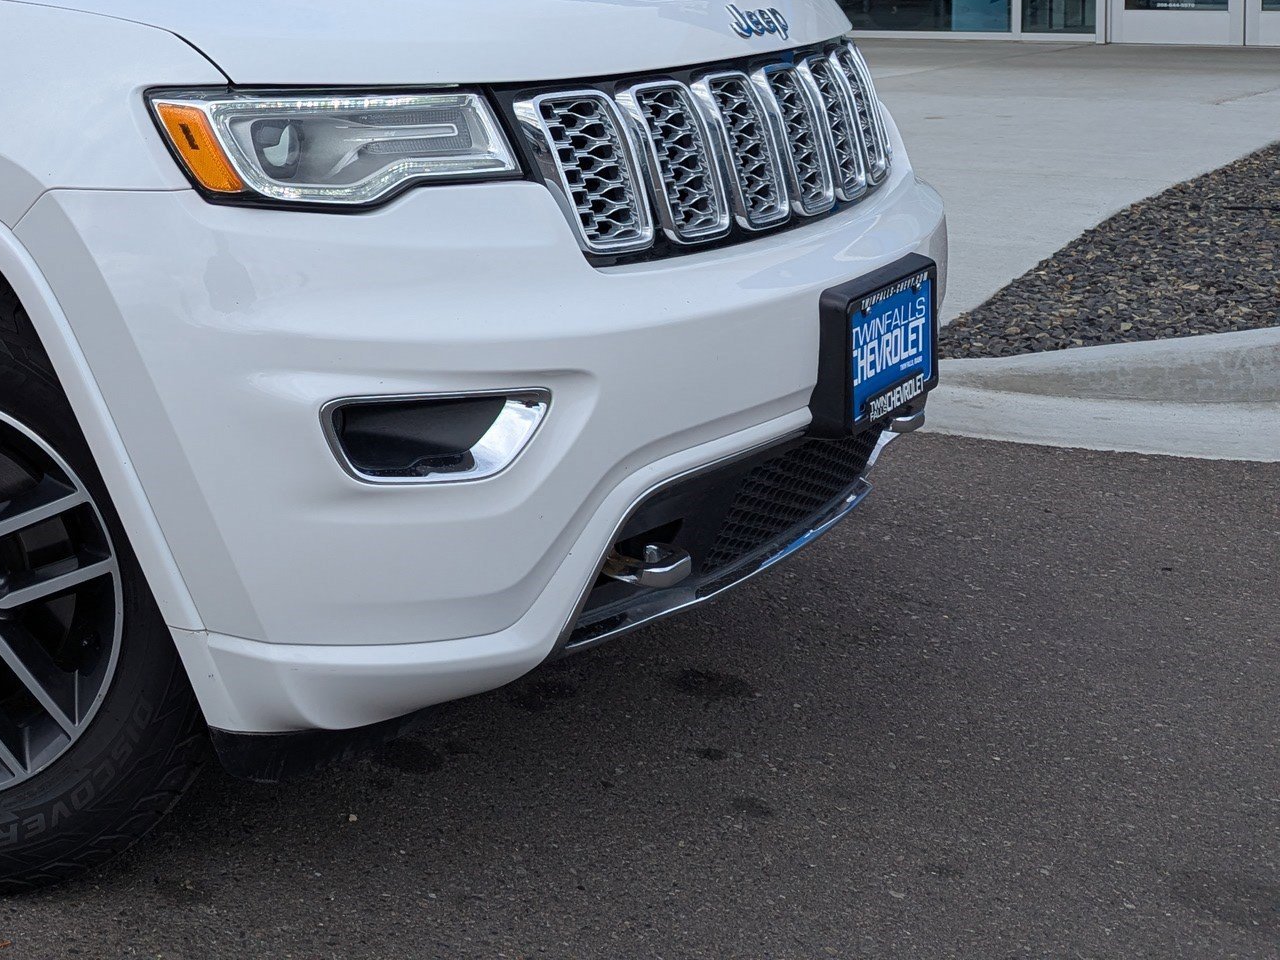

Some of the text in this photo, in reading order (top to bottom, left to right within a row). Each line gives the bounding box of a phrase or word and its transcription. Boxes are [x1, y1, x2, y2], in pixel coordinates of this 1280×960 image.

[725, 4, 788, 40] Jeep
[852, 297, 926, 350] TWINFALLS
[853, 317, 926, 386] CHEVROLET
